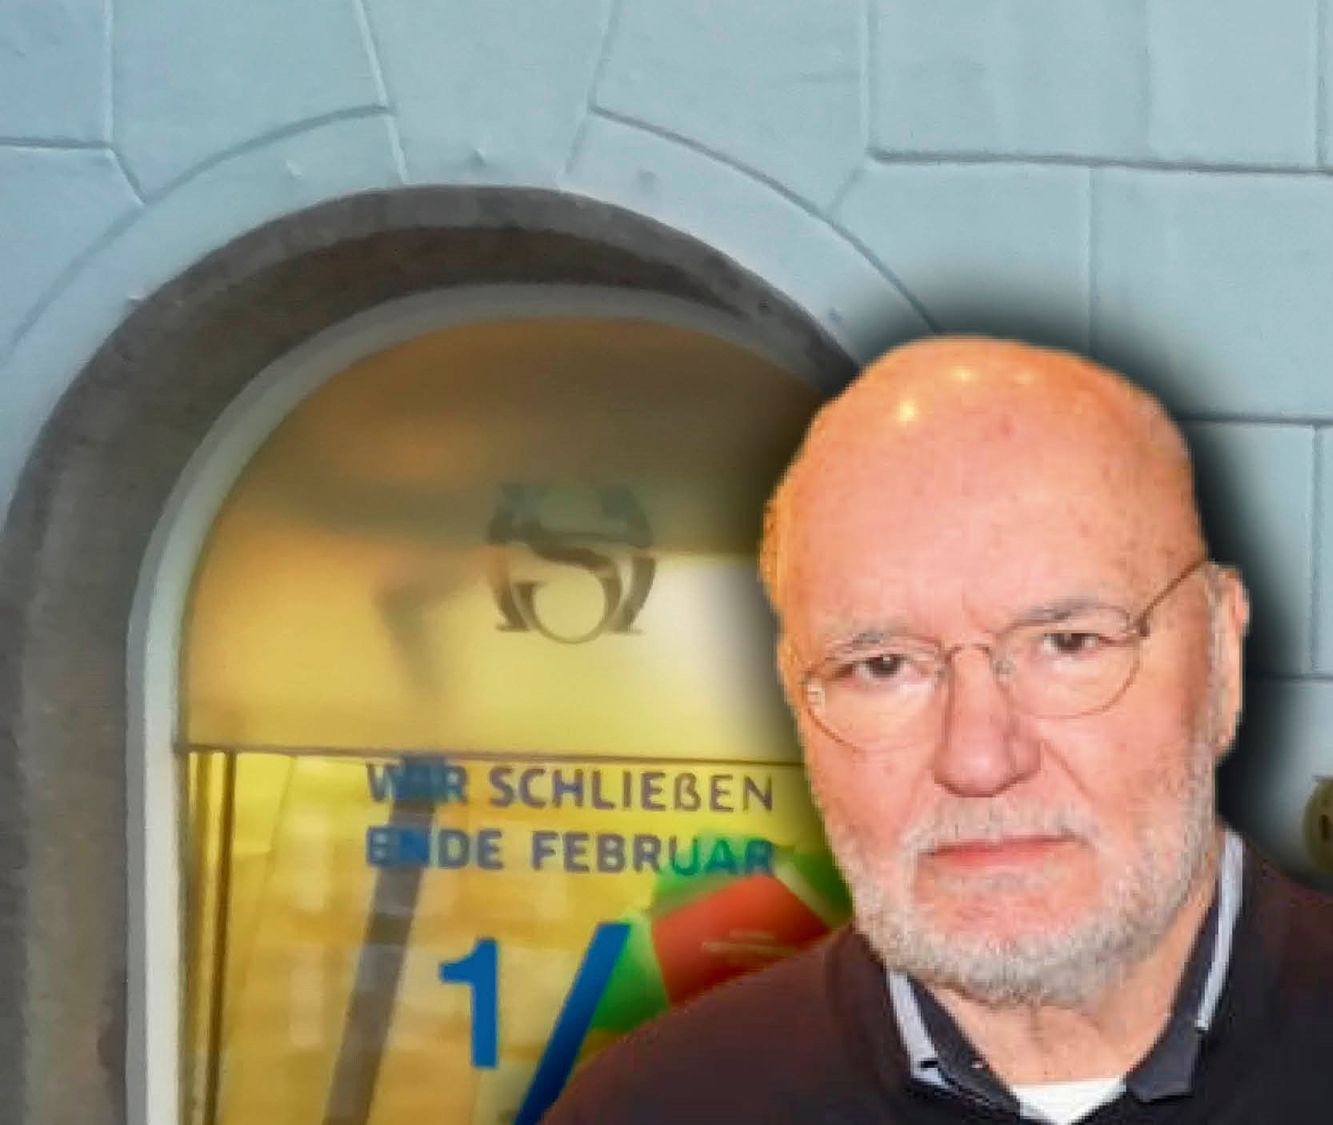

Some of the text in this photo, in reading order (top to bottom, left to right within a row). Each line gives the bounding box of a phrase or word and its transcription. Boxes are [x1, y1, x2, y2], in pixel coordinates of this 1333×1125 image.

[365, 758, 467, 805] WIR
[366, 825, 774, 878] ENDE FEBRUAR
